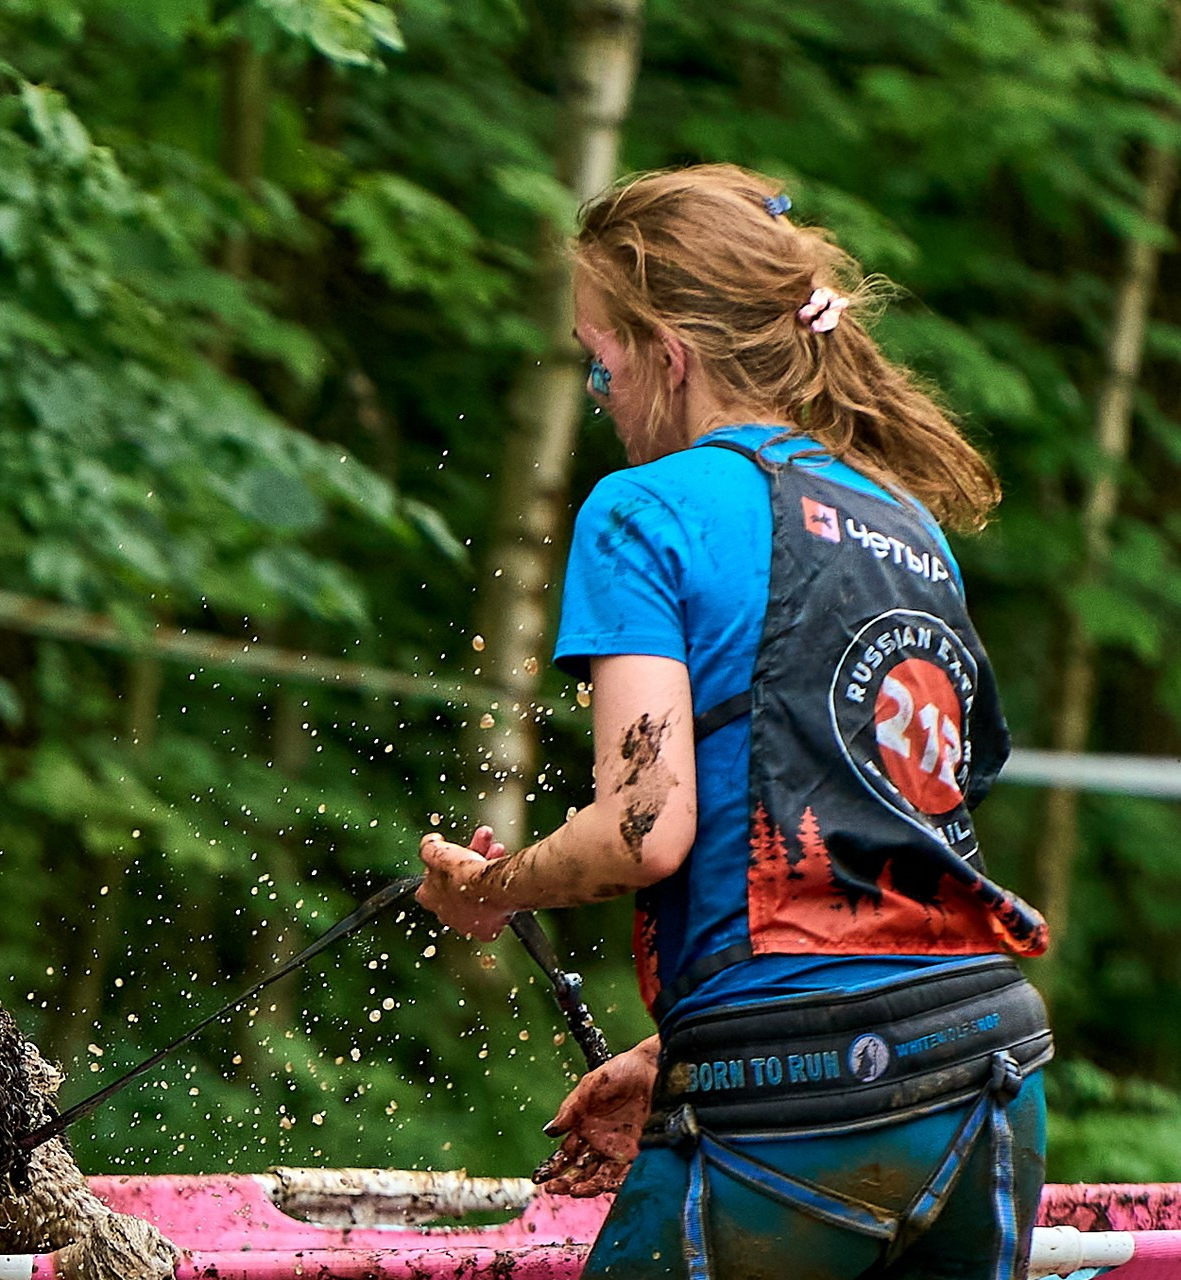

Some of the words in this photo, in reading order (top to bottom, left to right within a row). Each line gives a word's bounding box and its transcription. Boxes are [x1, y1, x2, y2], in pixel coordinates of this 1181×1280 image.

[845, 518, 950, 583] четыр
[845, 625, 932, 704] RUSSIAN
[685, 1059, 746, 1093] BORN
[749, 1055, 783, 1087] TO
[787, 1050, 841, 1084] RUN
